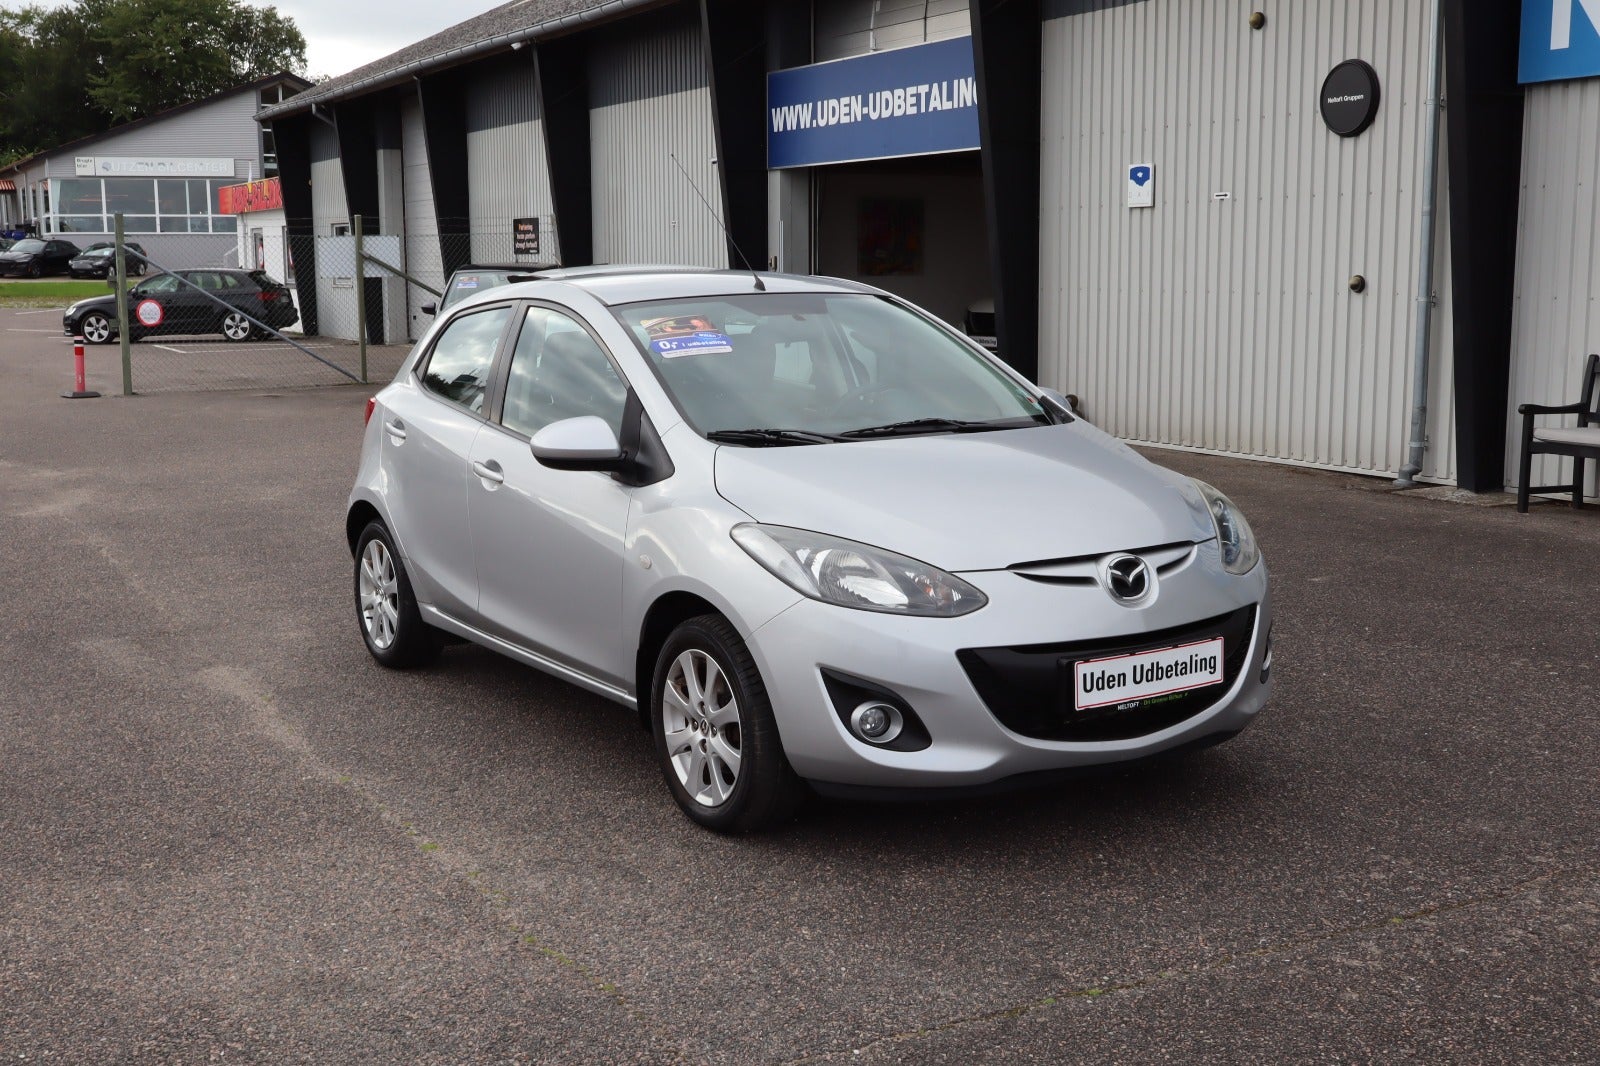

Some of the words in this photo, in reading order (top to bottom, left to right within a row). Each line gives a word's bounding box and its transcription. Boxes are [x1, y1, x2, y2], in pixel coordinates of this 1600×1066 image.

[771, 77, 978, 133] WWW.UDEN-UDBETALIN
[1082, 669, 1127, 694] Uden
[1132, 653, 1217, 684] Udbetaling
